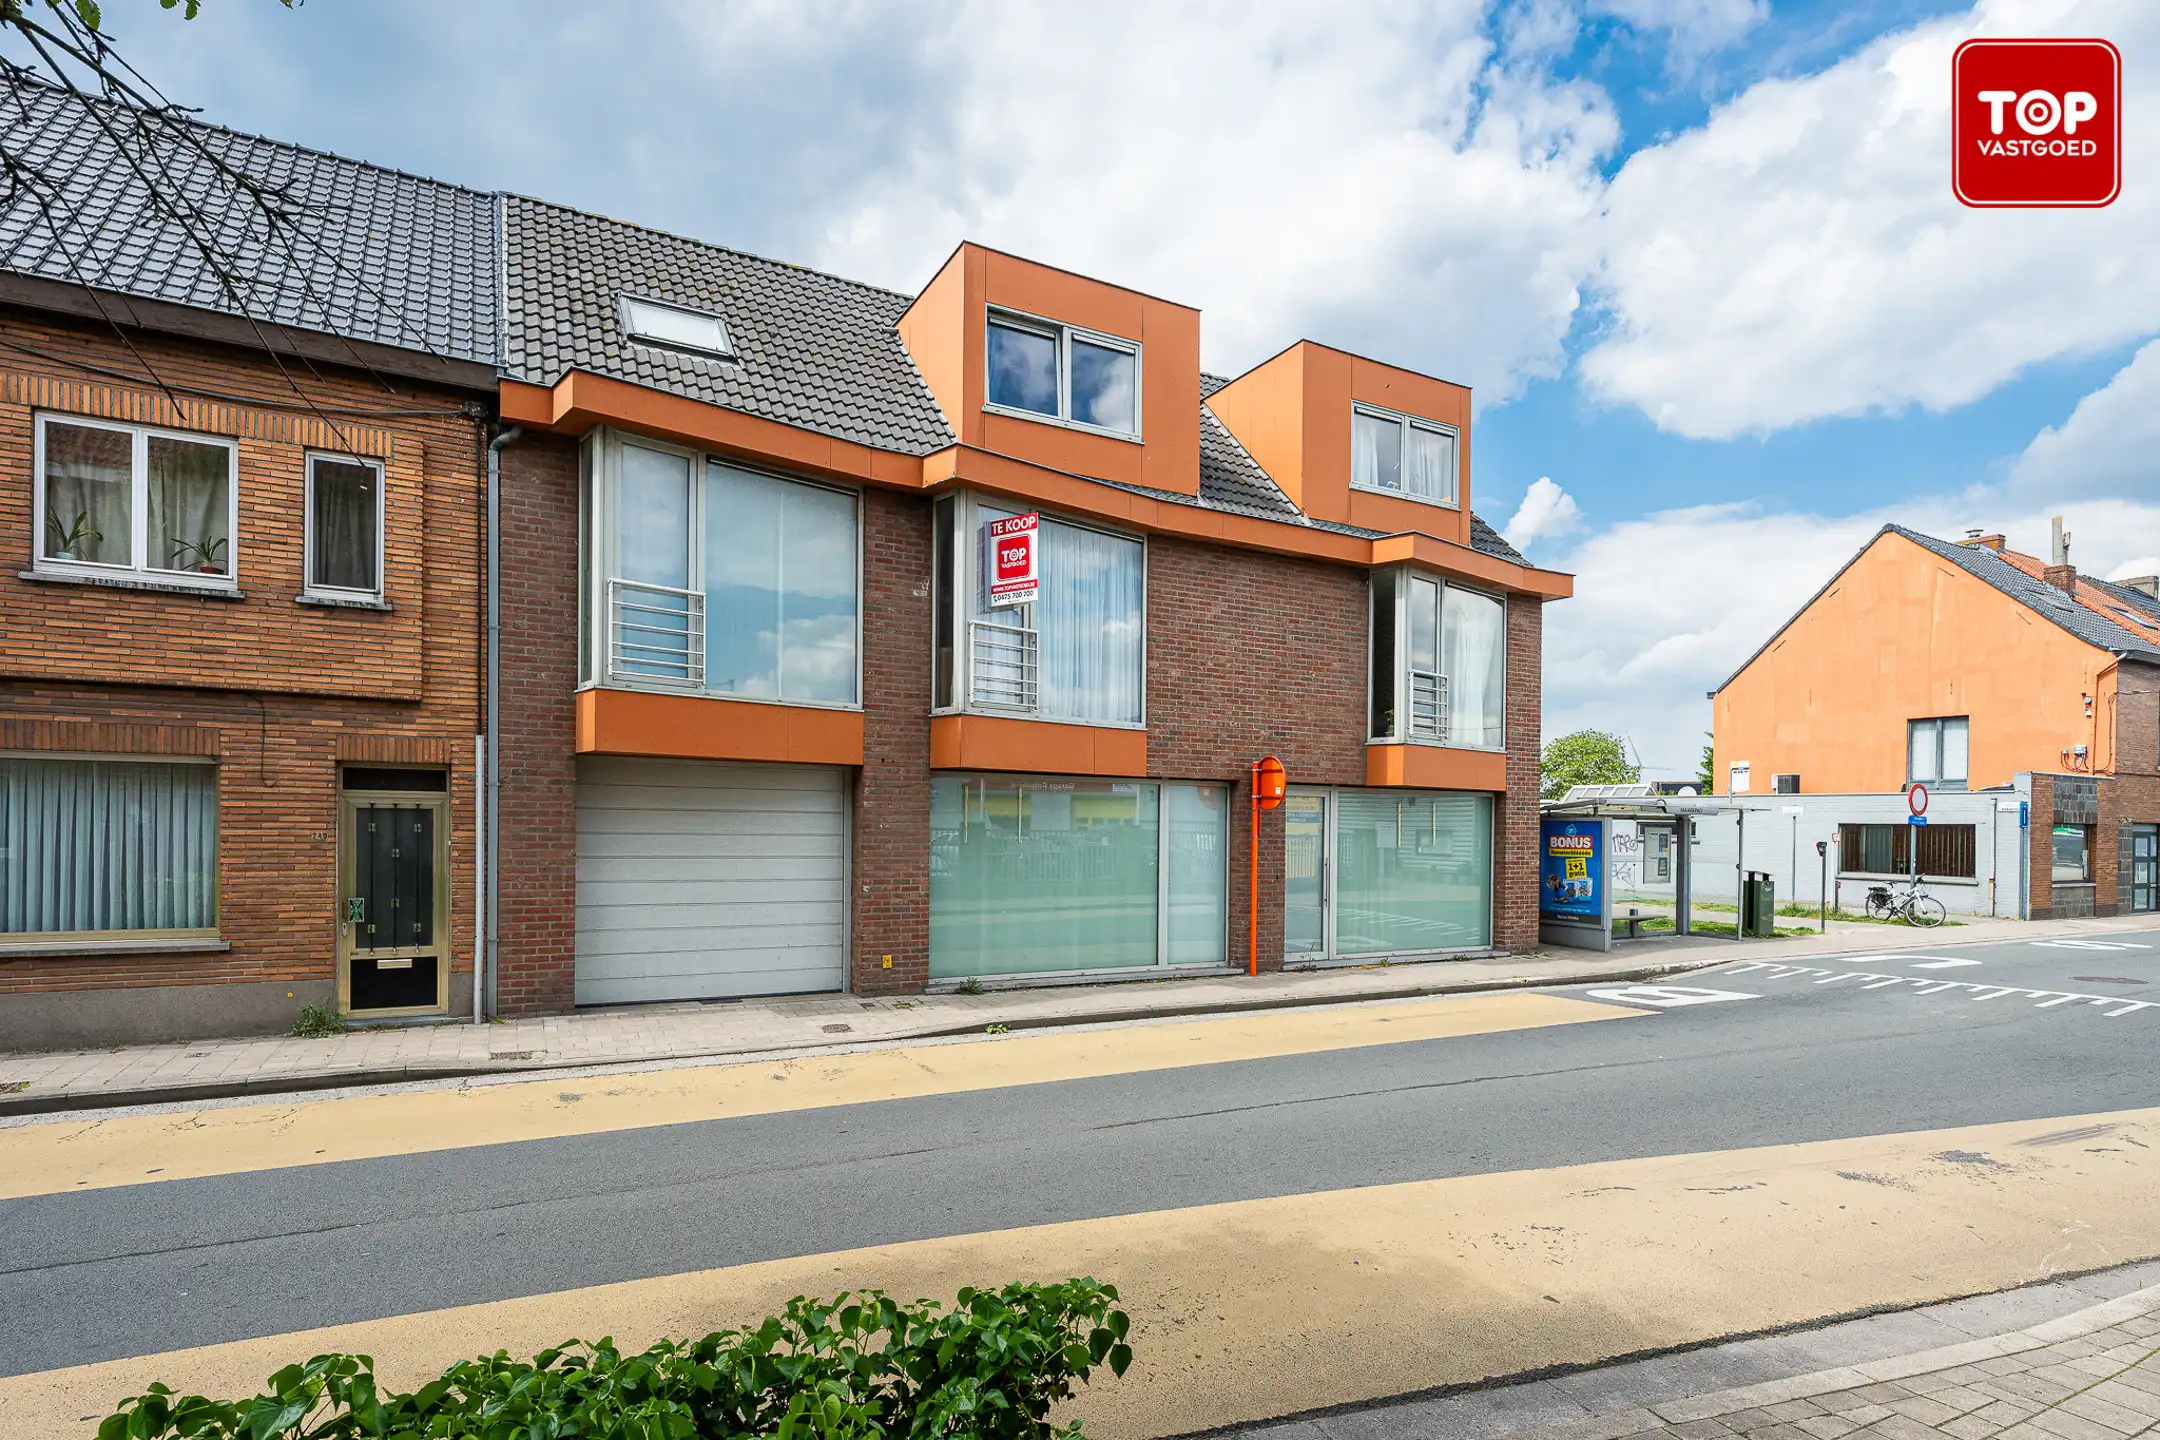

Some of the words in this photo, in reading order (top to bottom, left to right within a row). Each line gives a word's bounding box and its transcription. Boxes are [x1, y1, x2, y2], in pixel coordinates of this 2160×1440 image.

[991, 522, 1004, 535] TE
[1005, 516, 1036, 532] KOOP
[1001, 547, 1027, 563] TOP
[1550, 837, 1591, 848] BONUS
[1567, 863, 1584, 871] 1+1
